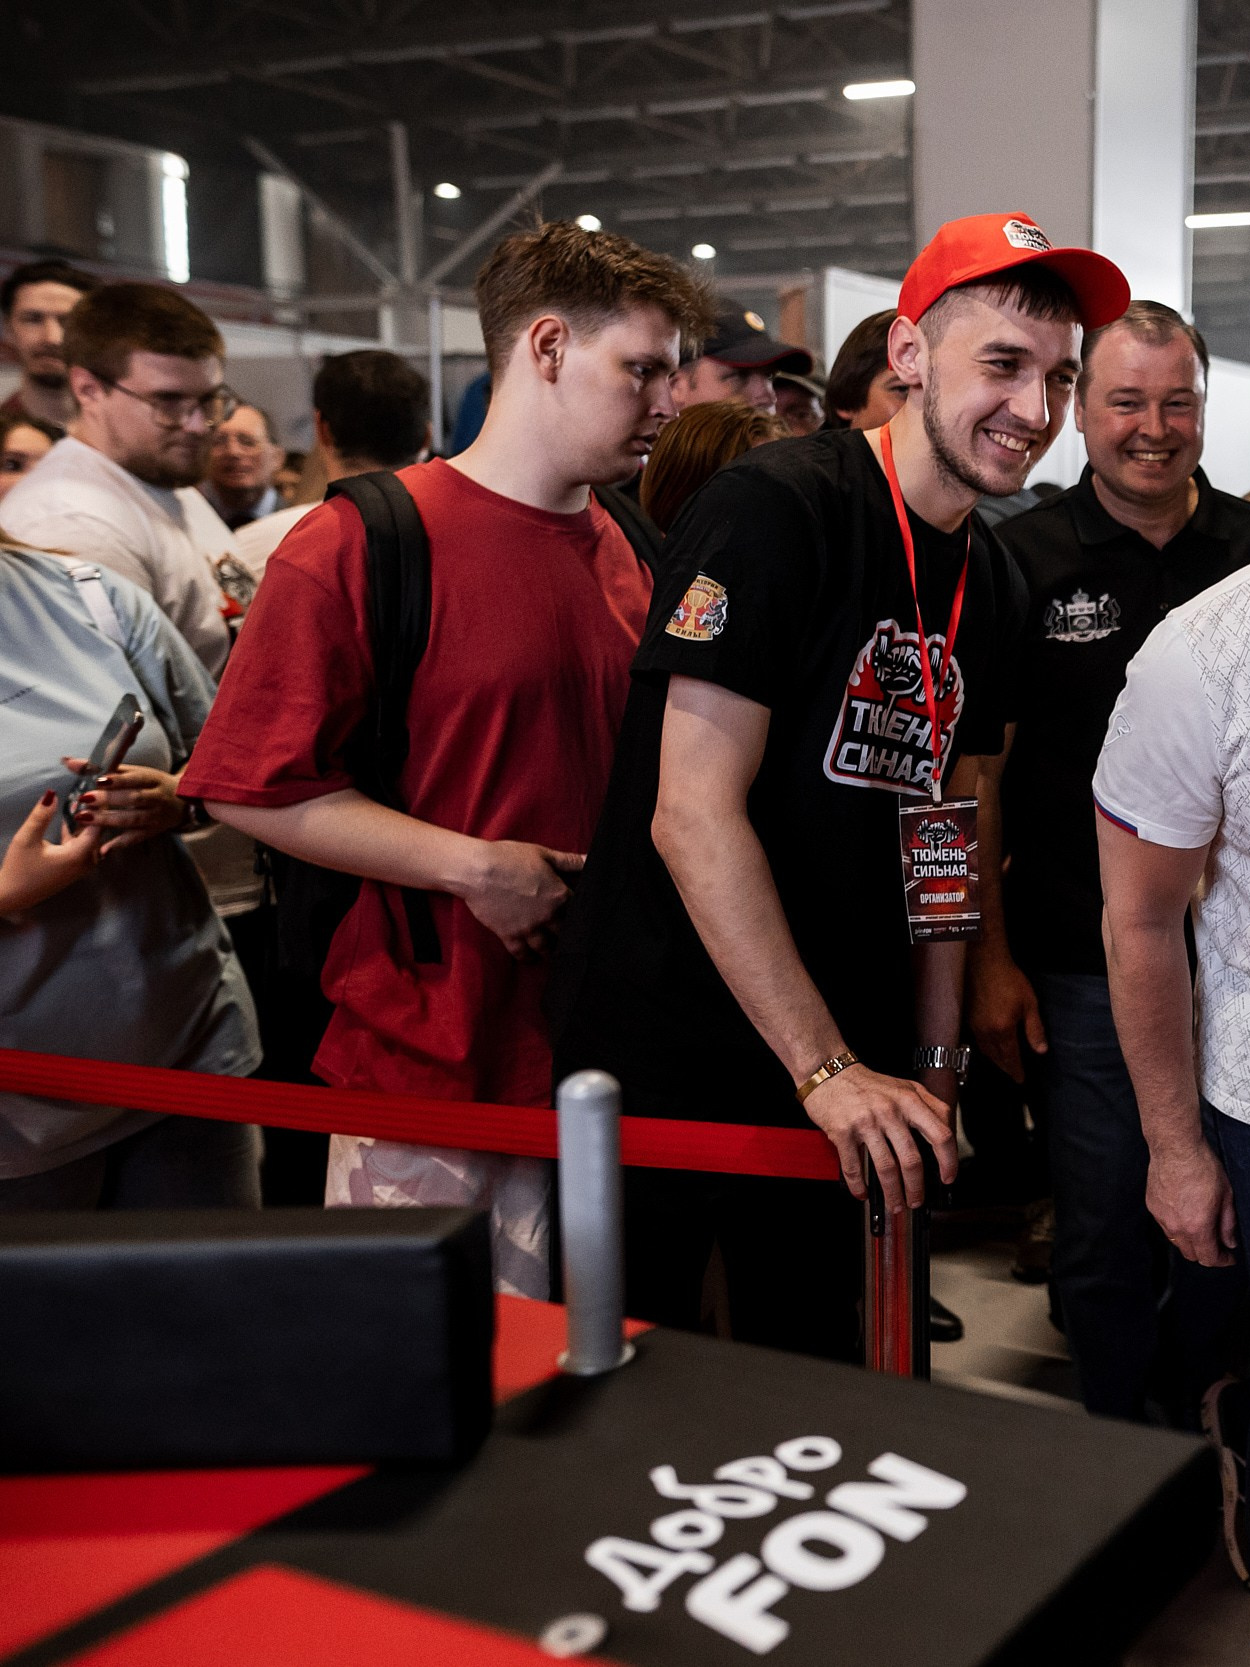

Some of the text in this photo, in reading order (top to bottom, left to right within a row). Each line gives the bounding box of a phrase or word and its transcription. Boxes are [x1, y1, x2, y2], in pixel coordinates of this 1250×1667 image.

[675, 627, 702, 638] СИЛЫ
[837, 741, 934, 787] СИНАЯ
[912, 848, 967, 862] ТЮМЕНЬ
[913, 864, 968, 878] СИЛЬНАЯ
[920, 892, 965, 904] ОРГАНИЗАТОР
[585, 1435, 842, 1612] Добро
[685, 1452, 967, 1655] FON
